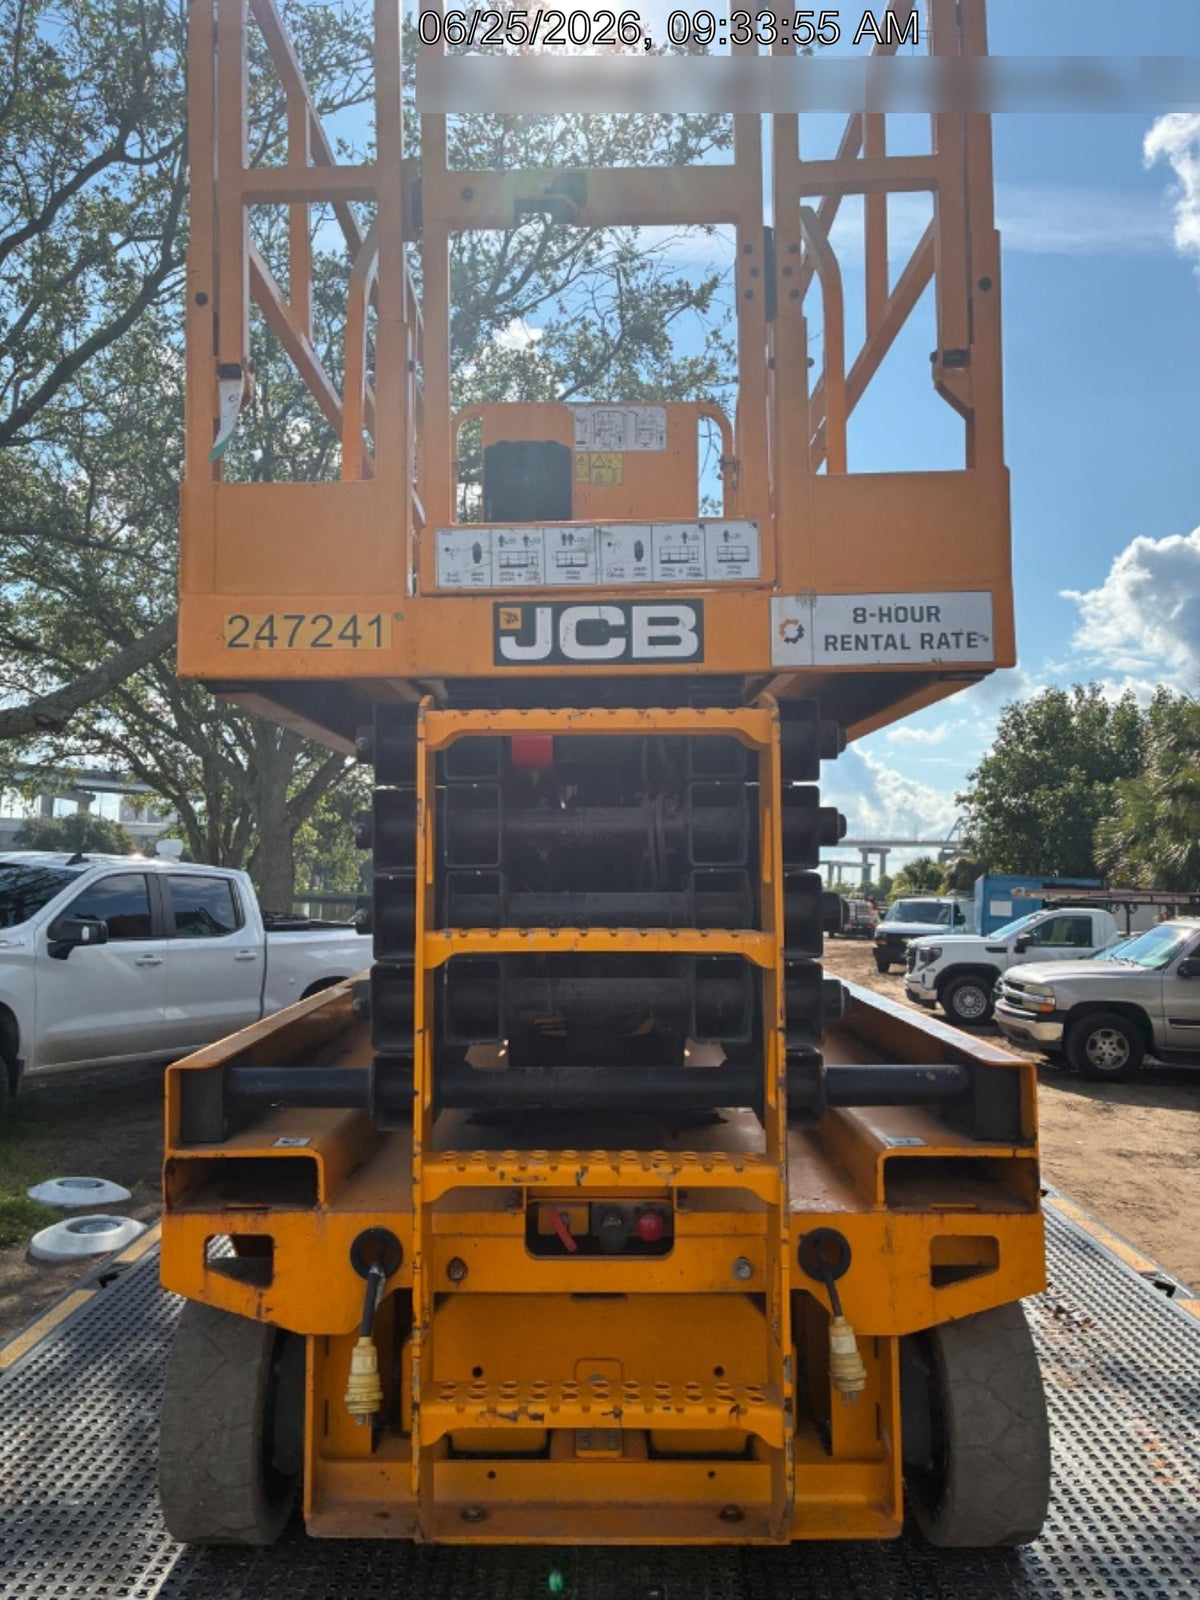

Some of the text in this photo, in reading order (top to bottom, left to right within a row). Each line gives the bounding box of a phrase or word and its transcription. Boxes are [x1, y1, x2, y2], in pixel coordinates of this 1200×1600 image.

[852, 606, 941, 624] 8-HOUR
[228, 613, 384, 648] 247241
[500, 606, 698, 660] JCB
[824, 632, 979, 652] RENTAL RATE
